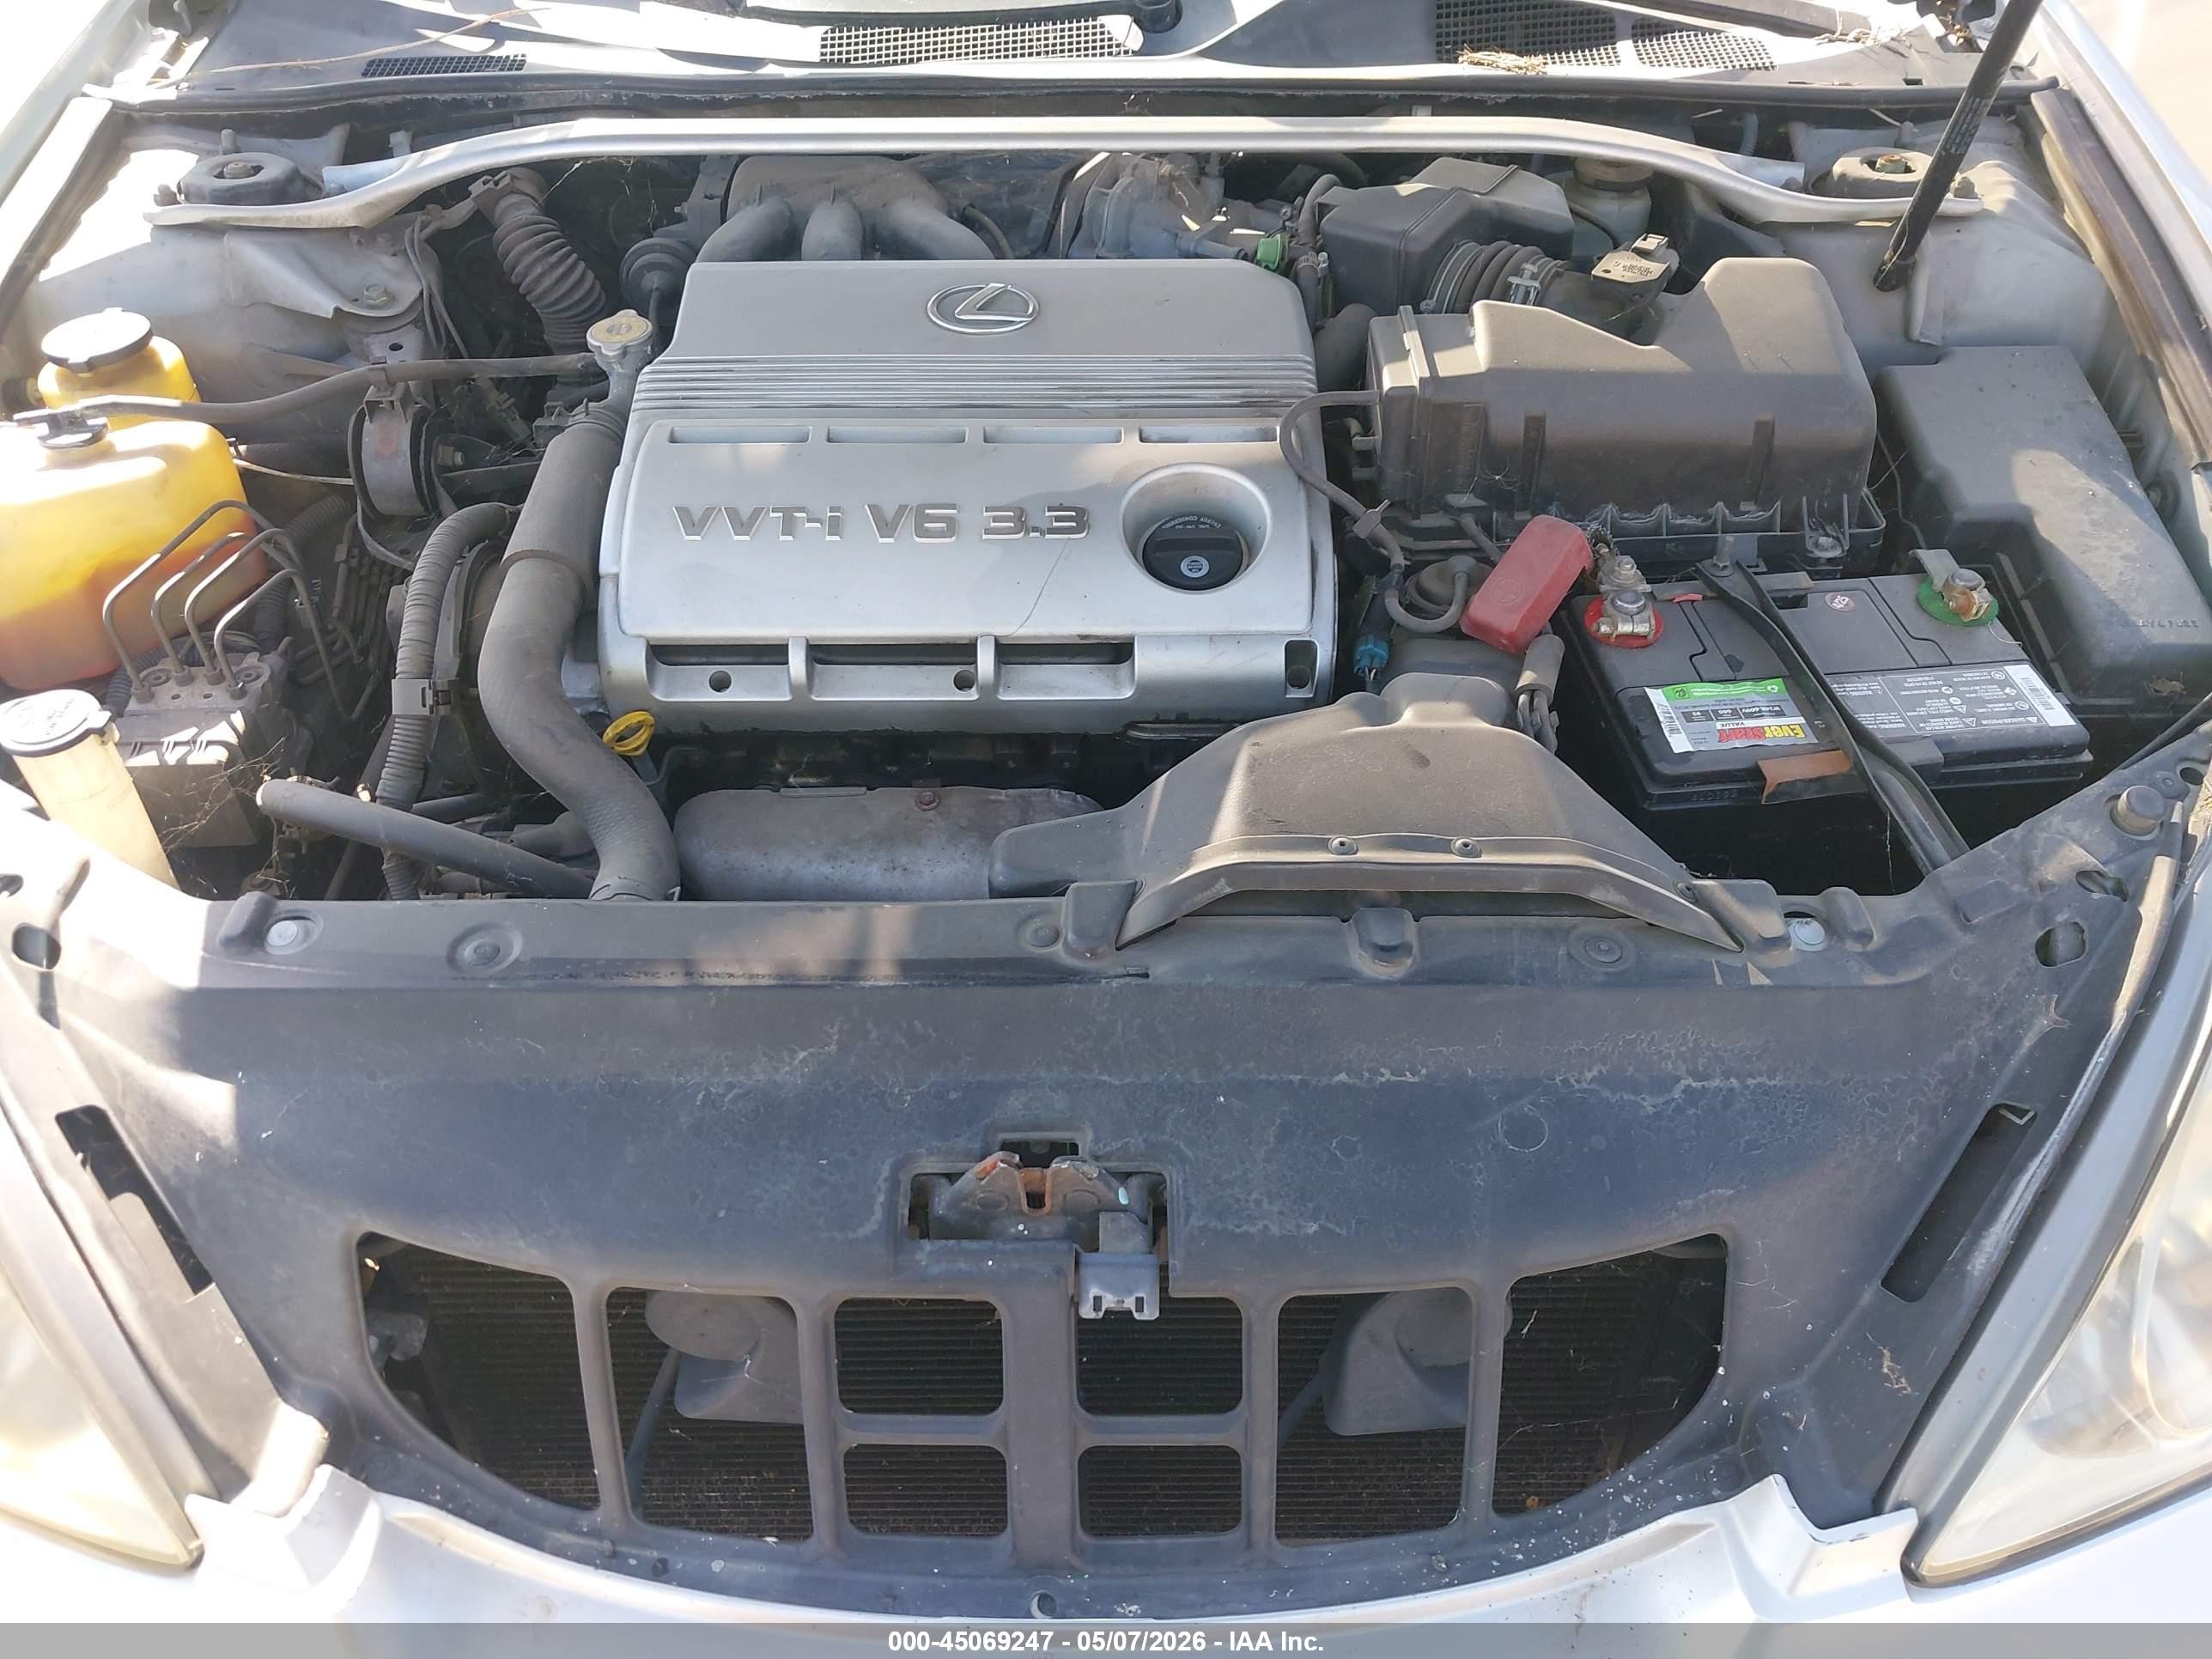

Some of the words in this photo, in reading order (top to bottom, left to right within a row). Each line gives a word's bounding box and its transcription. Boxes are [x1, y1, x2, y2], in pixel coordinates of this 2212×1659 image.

[673, 506, 842, 541] VVT-i
[866, 504, 960, 543] V6
[981, 504, 1088, 539] 3.3
[1718, 724, 1807, 743] EverStart
